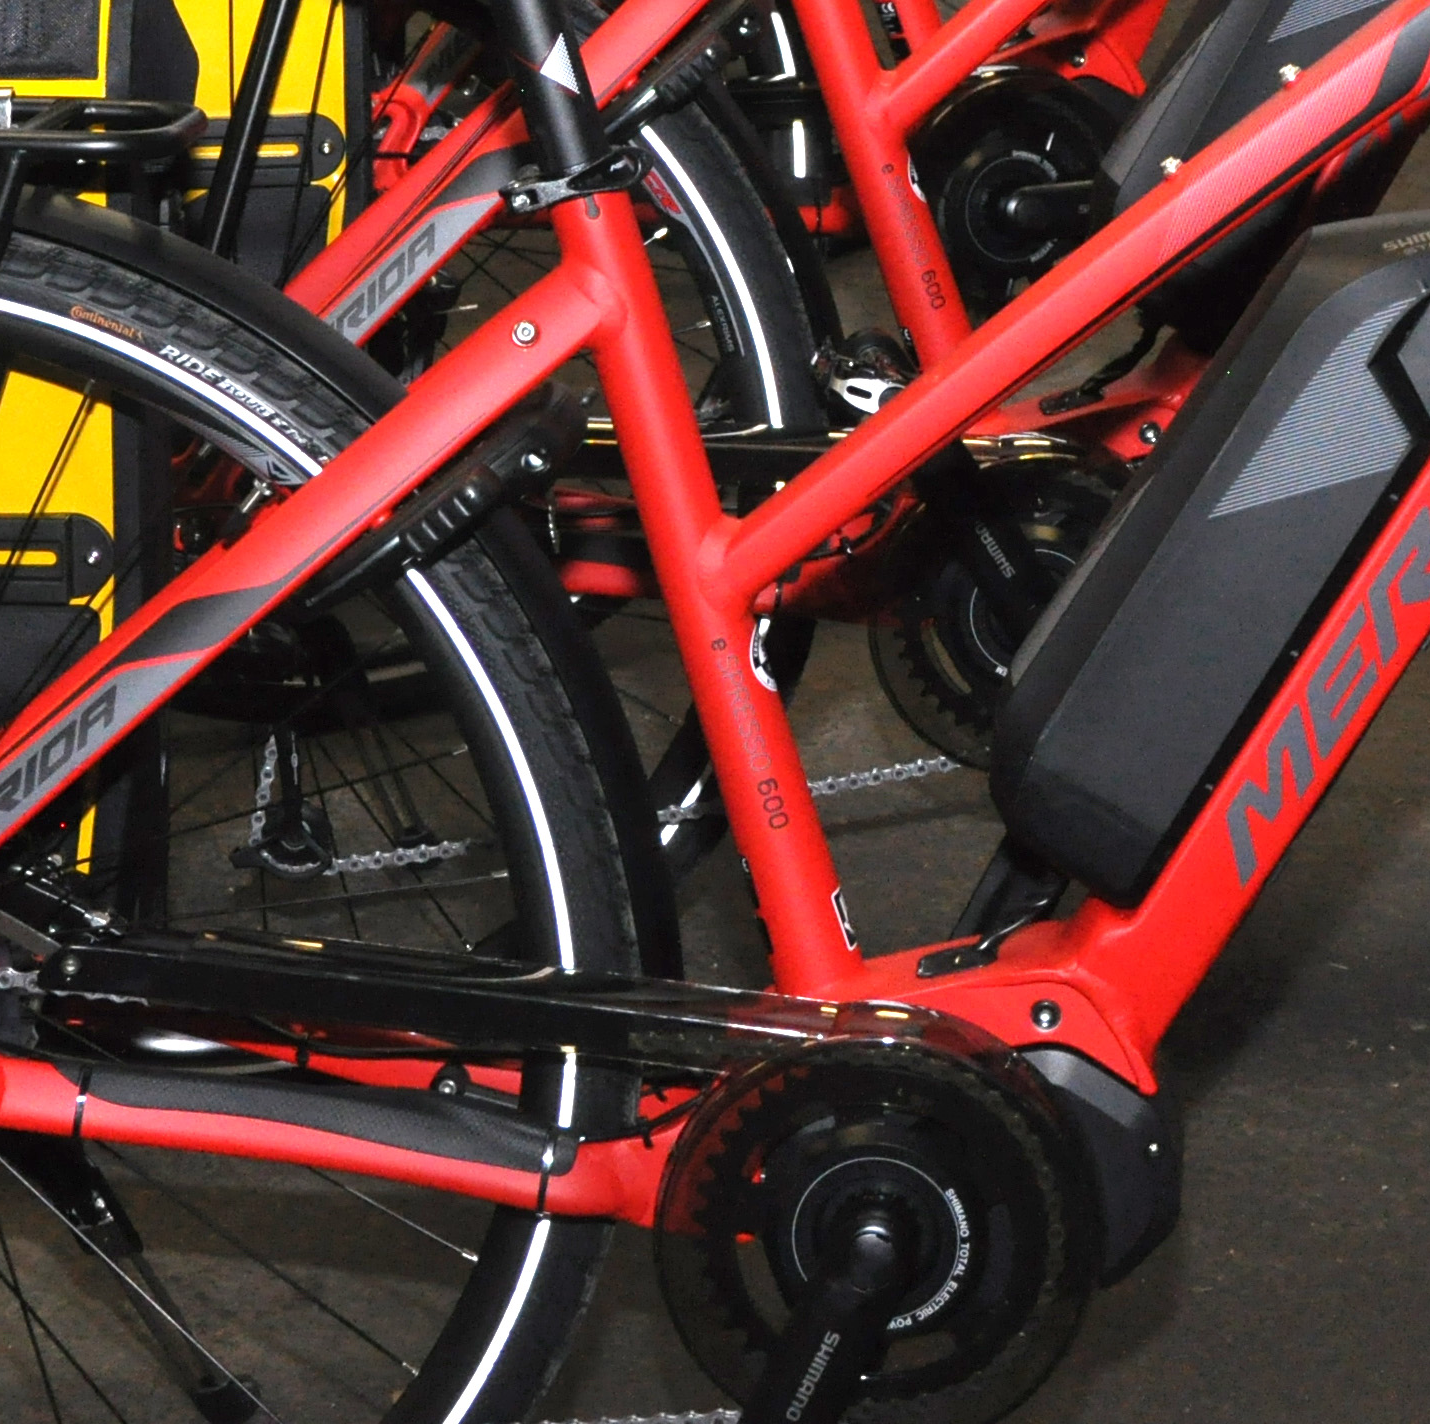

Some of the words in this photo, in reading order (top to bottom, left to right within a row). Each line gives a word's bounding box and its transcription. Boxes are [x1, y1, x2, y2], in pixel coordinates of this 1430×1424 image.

[334, 221, 436, 331] RIDA
[921, 269, 947, 311] 600
[159, 344, 222, 386] RIDE
[757, 778, 790, 830] 600
[945, 1187, 970, 1238] SHIMANO
[953, 1242, 971, 1277] TOTAL
[917, 1280, 959, 1322] ELECTRIC
[785, 1329, 842, 1423] SHIMANO
